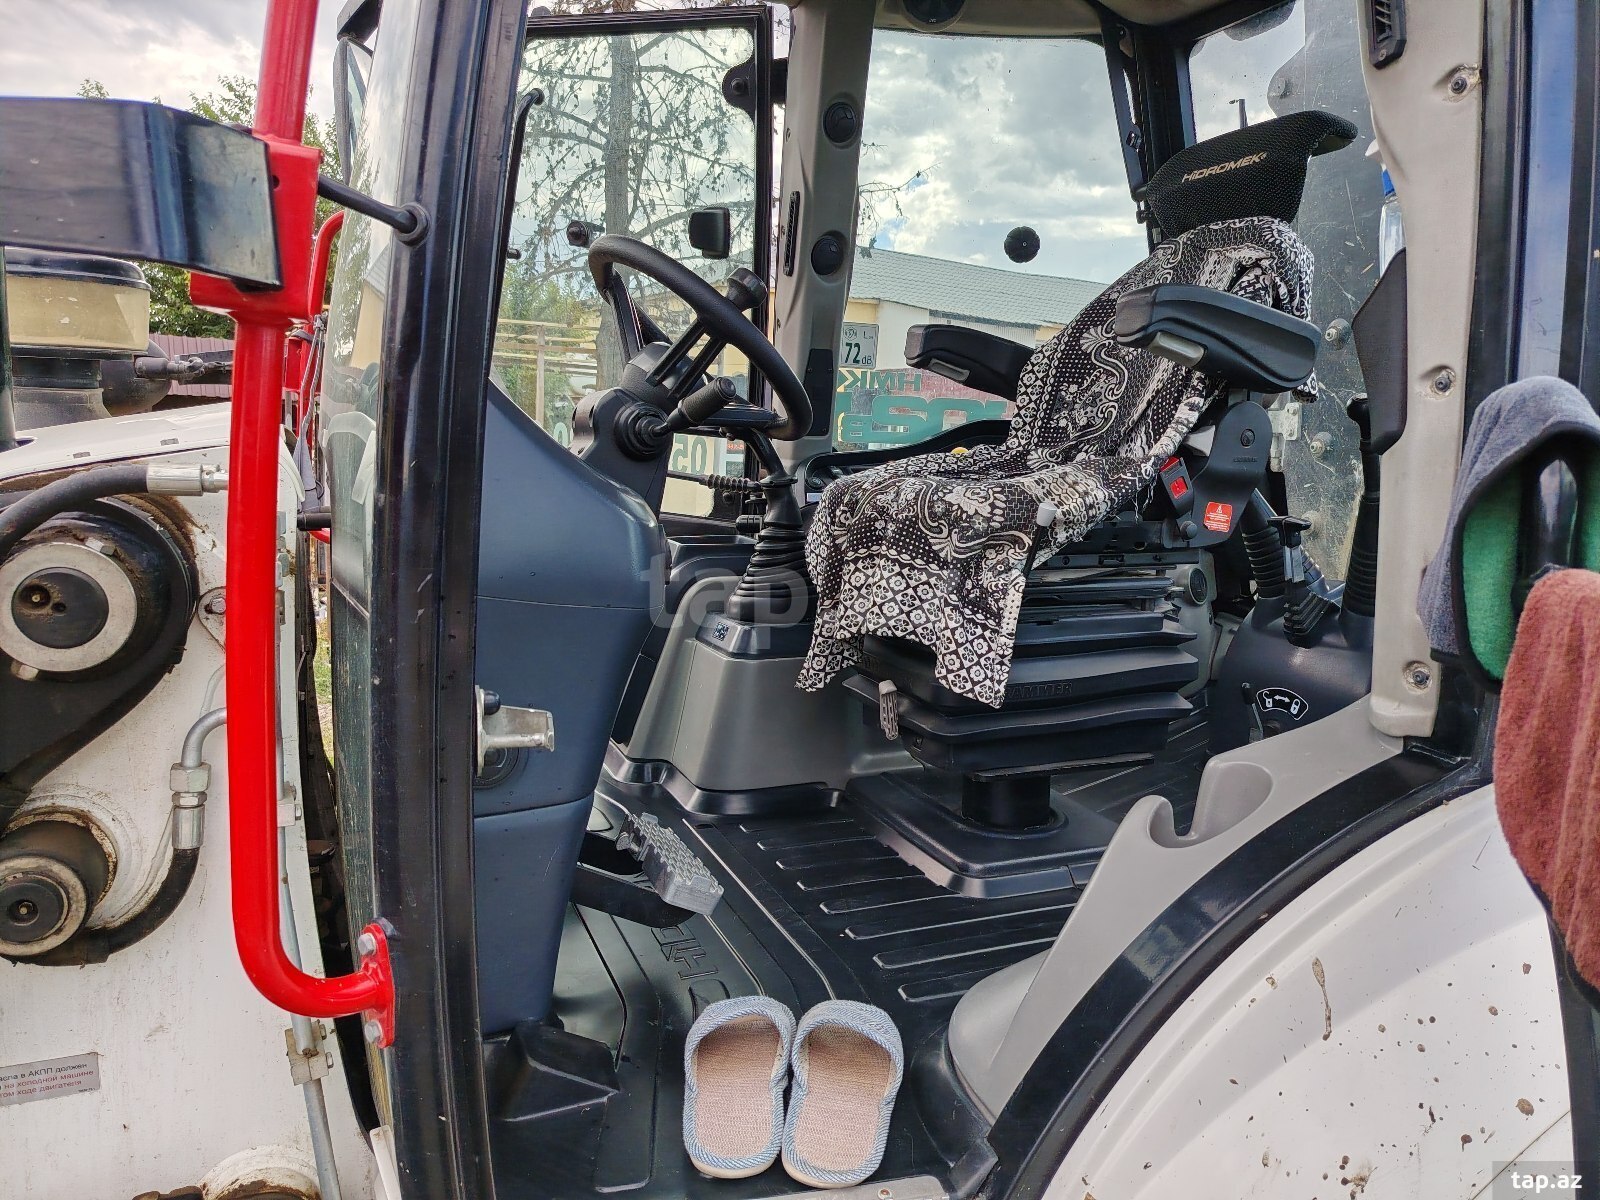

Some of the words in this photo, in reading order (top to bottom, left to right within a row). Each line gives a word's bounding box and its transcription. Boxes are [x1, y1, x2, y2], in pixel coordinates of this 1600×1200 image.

[845, 342, 861, 364] 72
[862, 355, 873, 365] dB
[28, 1067, 53, 1078] АКПП
[55, 1063, 88, 1073] должен
[60, 1070, 94, 1080] машине
[17, 1087, 37, 1095] ходе
